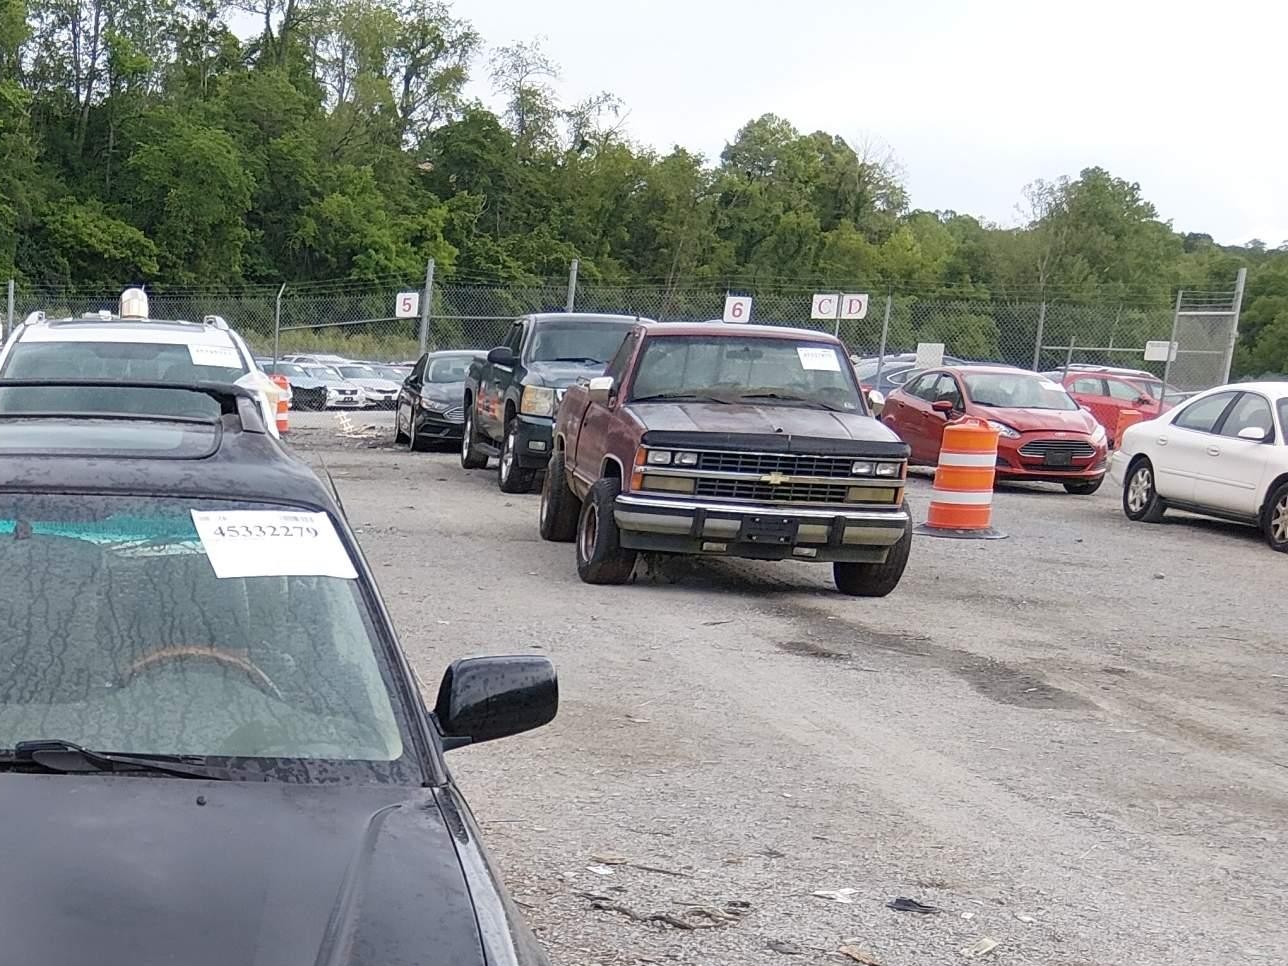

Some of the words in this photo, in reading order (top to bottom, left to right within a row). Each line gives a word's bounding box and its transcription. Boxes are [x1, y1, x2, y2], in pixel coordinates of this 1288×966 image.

[402, 297, 412, 313] 5
[731, 302, 744, 318] 6
[818, 298, 832, 315] C
[848, 298, 863, 315] D
[213, 525, 319, 538] 45332279
